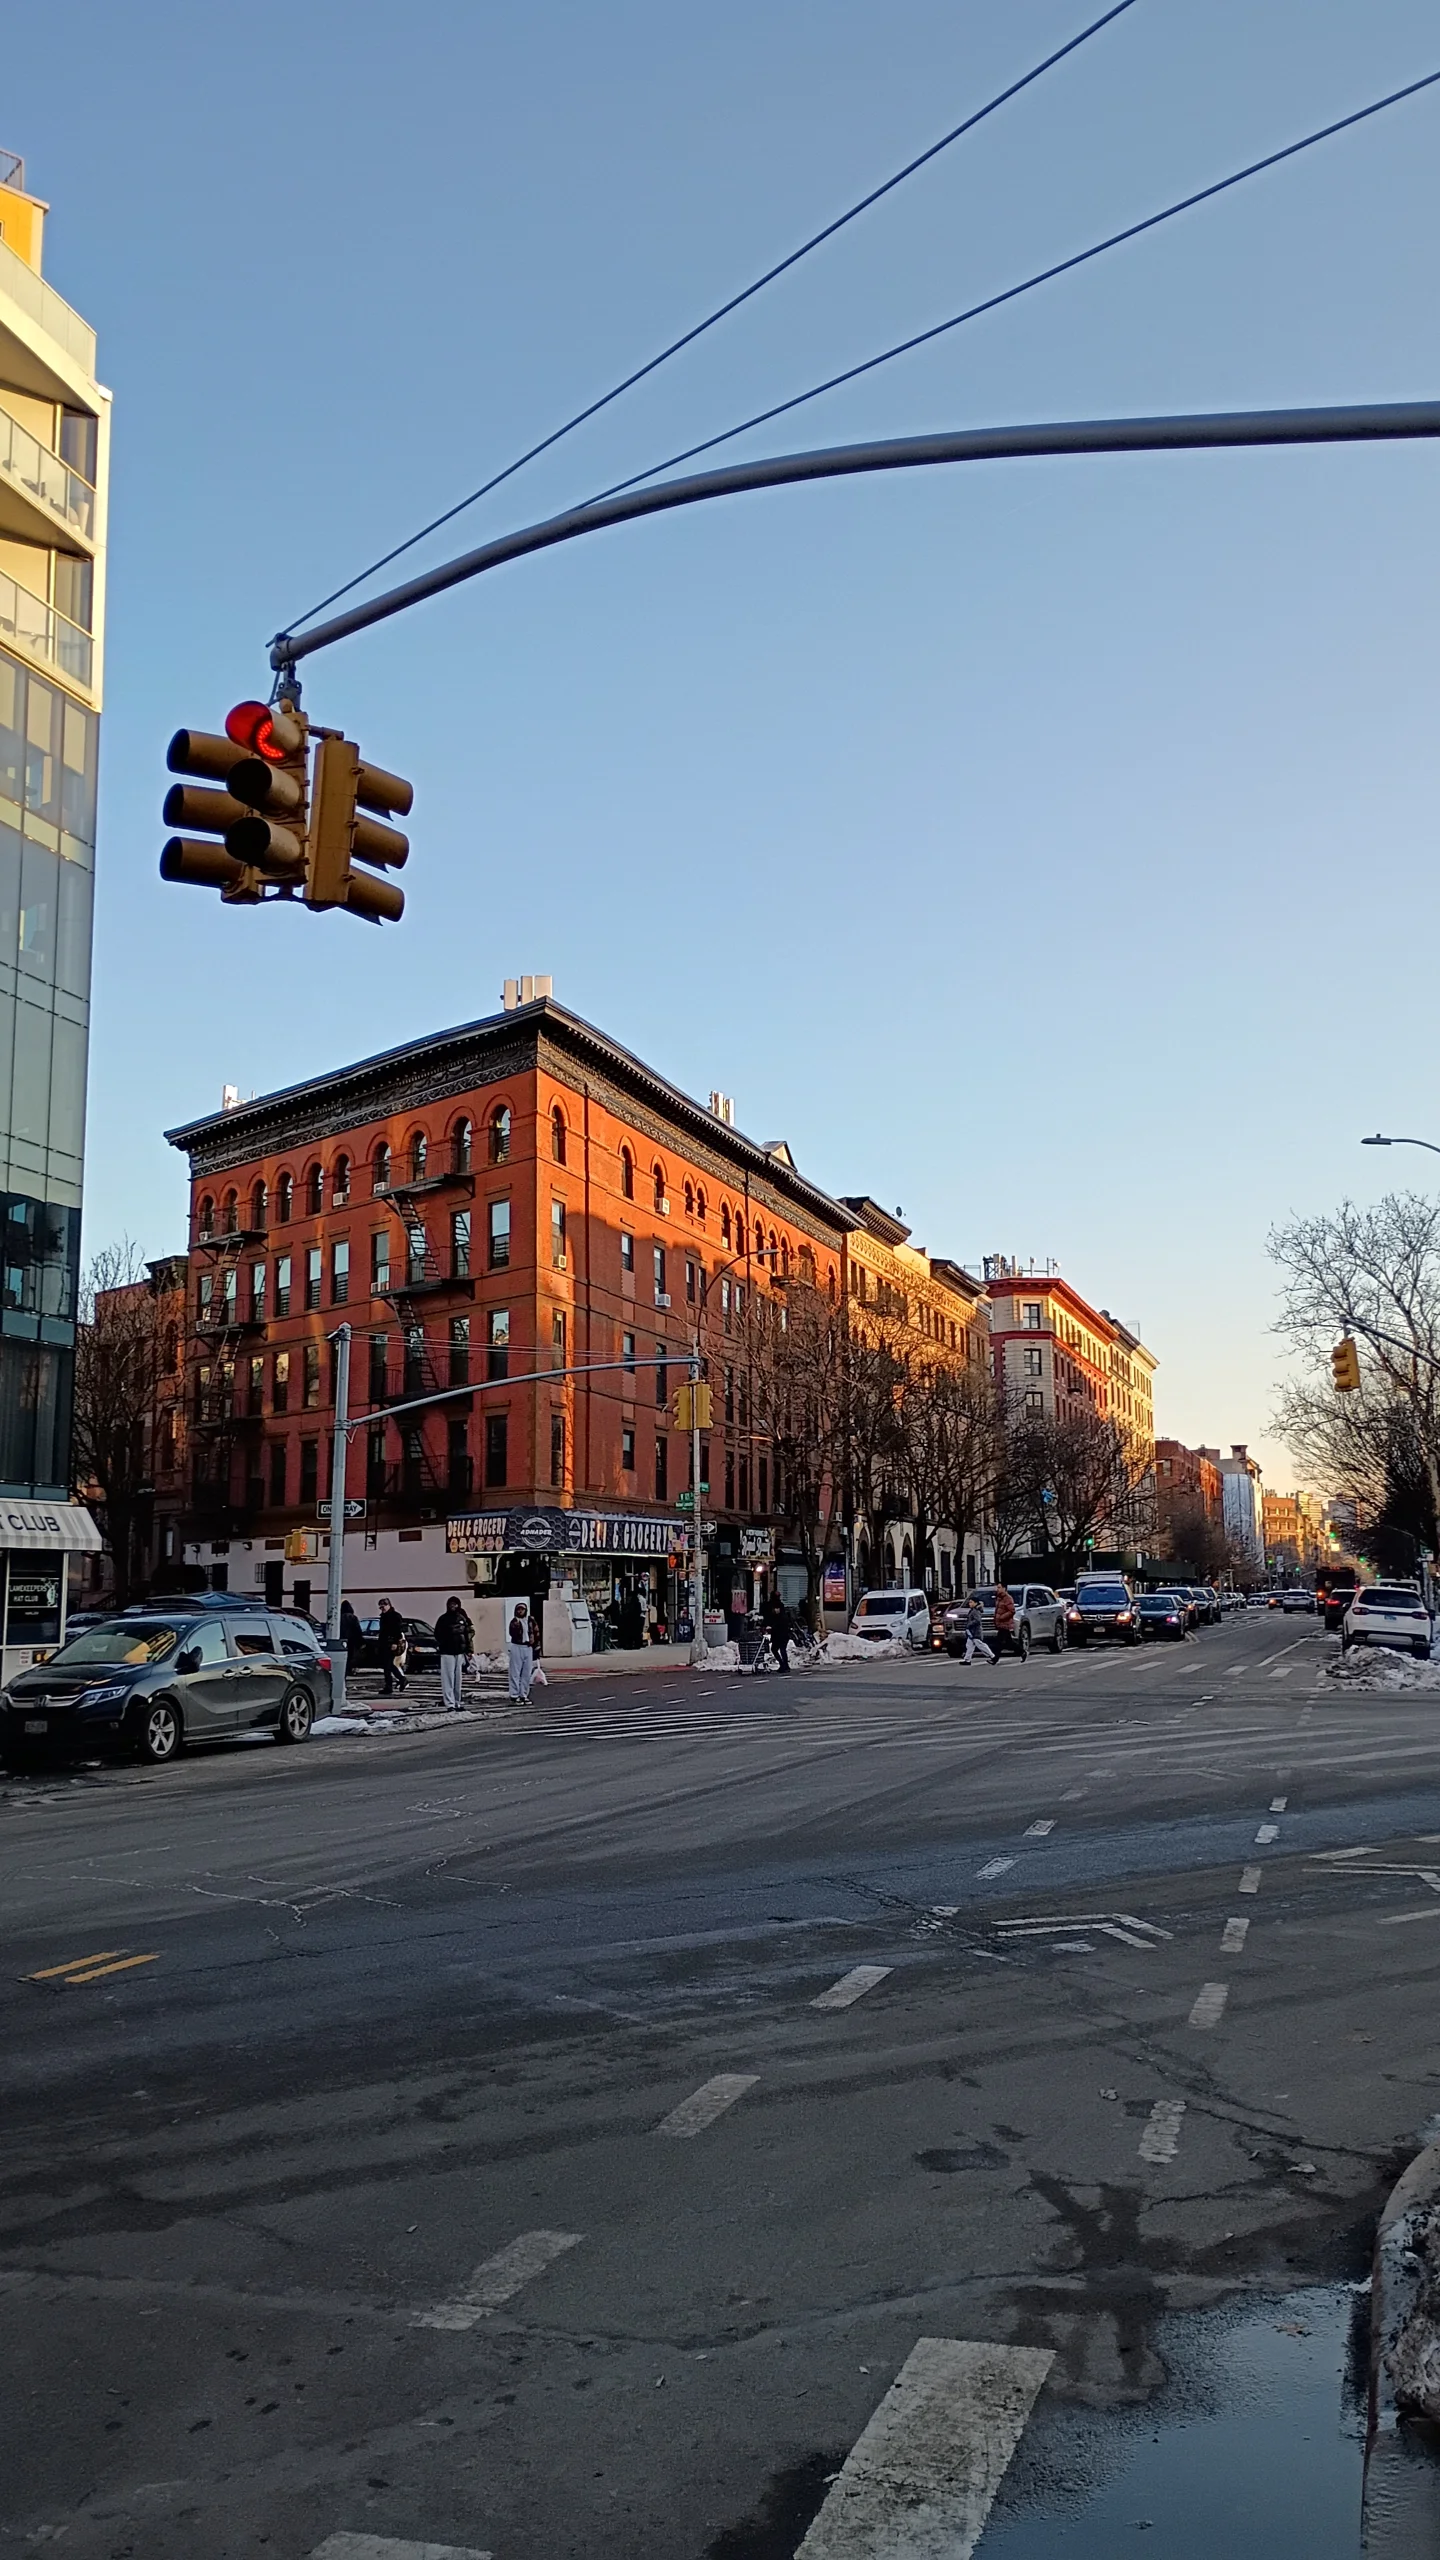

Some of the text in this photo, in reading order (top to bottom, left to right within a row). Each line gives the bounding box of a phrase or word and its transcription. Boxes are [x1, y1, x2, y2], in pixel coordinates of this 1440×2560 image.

[8, 1514, 61, 1531] CLUB
[447, 1520, 465, 1537] DELI
[473, 1517, 507, 1535] GROCERY
[581, 1520, 668, 1552] DELI & GROCERY
